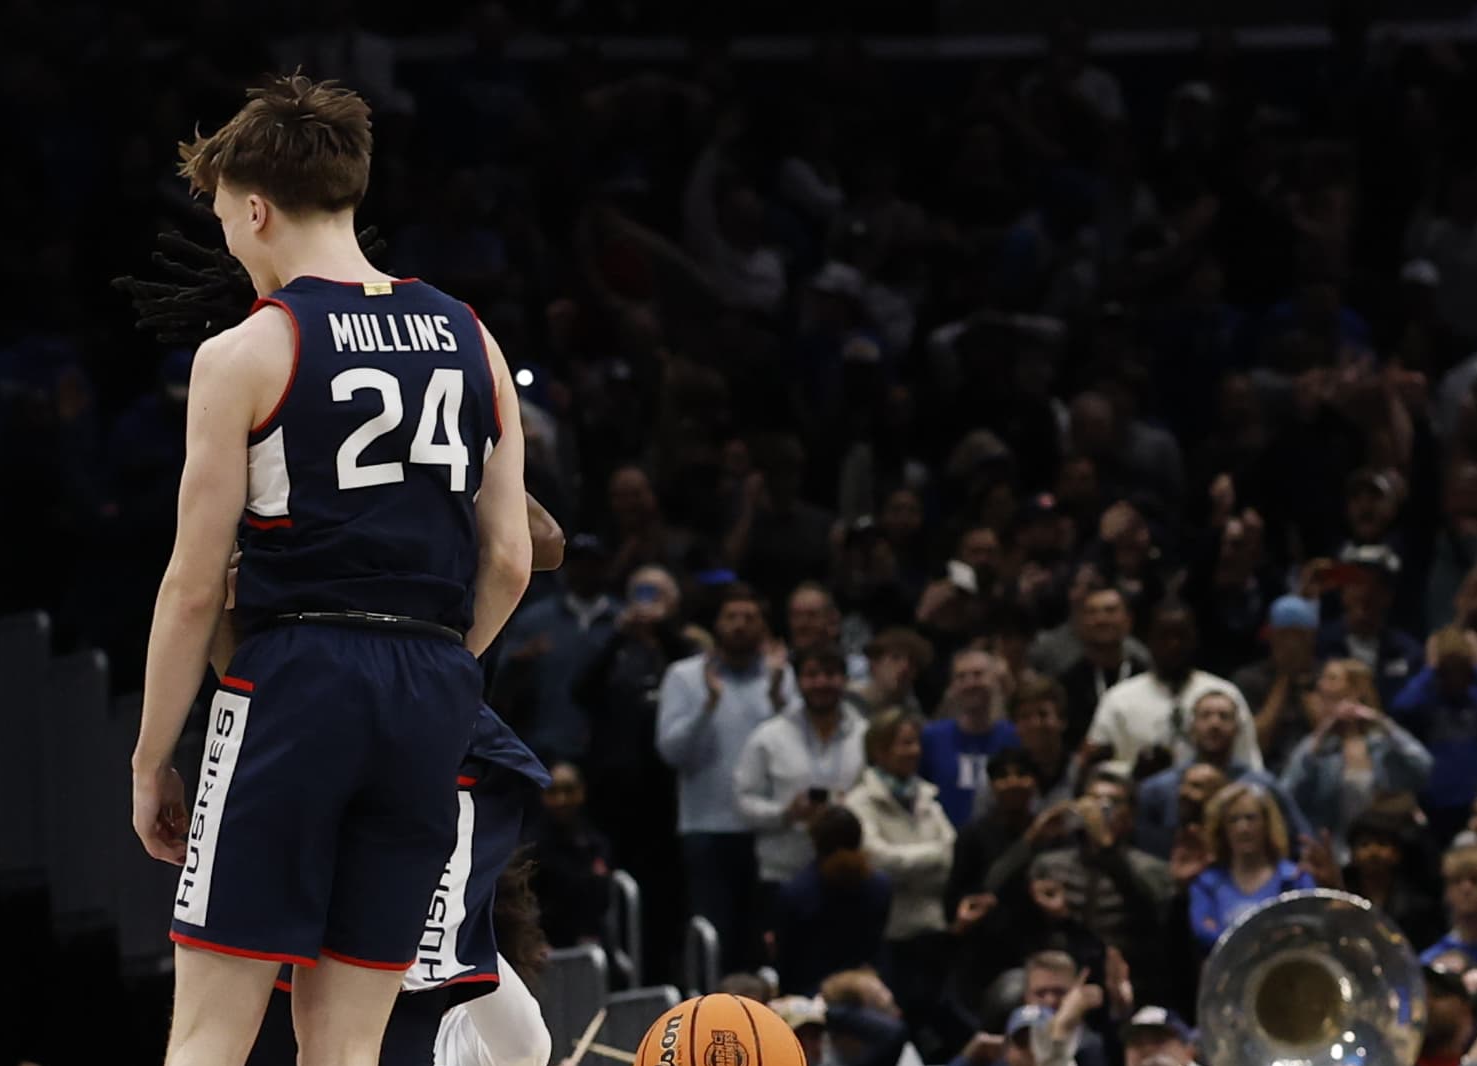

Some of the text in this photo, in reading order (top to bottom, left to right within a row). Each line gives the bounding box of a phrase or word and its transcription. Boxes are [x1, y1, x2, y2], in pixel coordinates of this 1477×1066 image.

[328, 313, 458, 352] MULLINS
[330, 367, 470, 492] 24
[176, 706, 235, 909] HUSKIES
